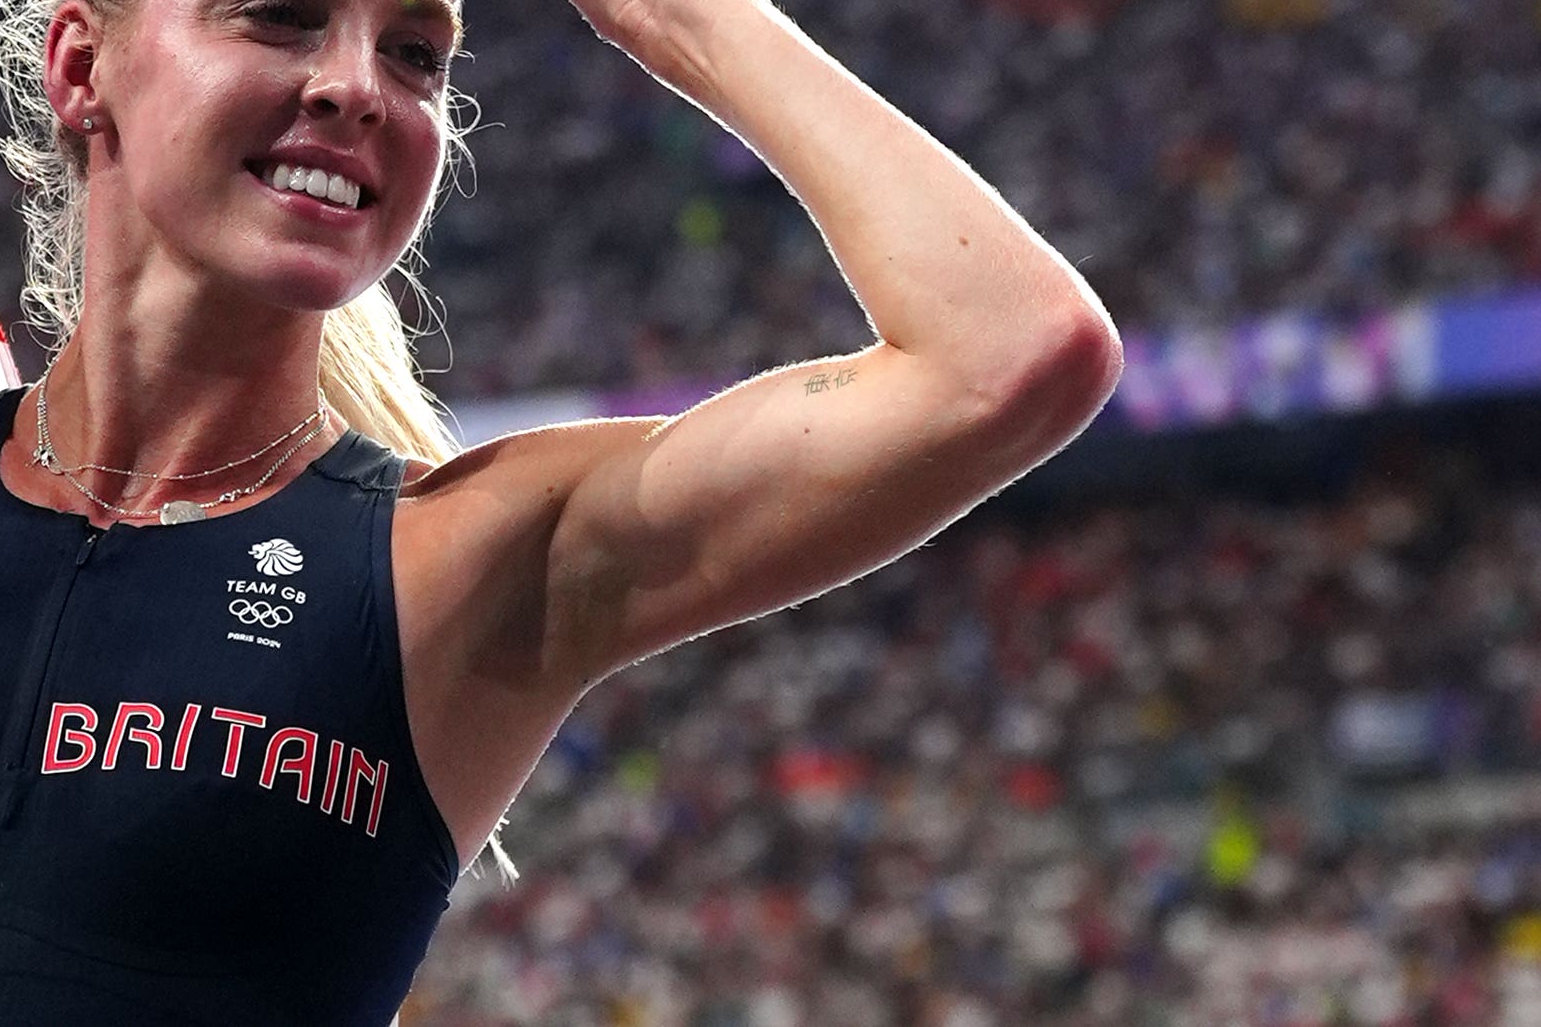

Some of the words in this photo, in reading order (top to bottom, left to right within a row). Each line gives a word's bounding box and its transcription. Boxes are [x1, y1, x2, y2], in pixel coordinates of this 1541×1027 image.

[227, 580, 277, 595] TEAM
[281, 586, 307, 604] GB
[227, 632, 255, 642] PARIS
[41, 702, 389, 838] BRITAIN
